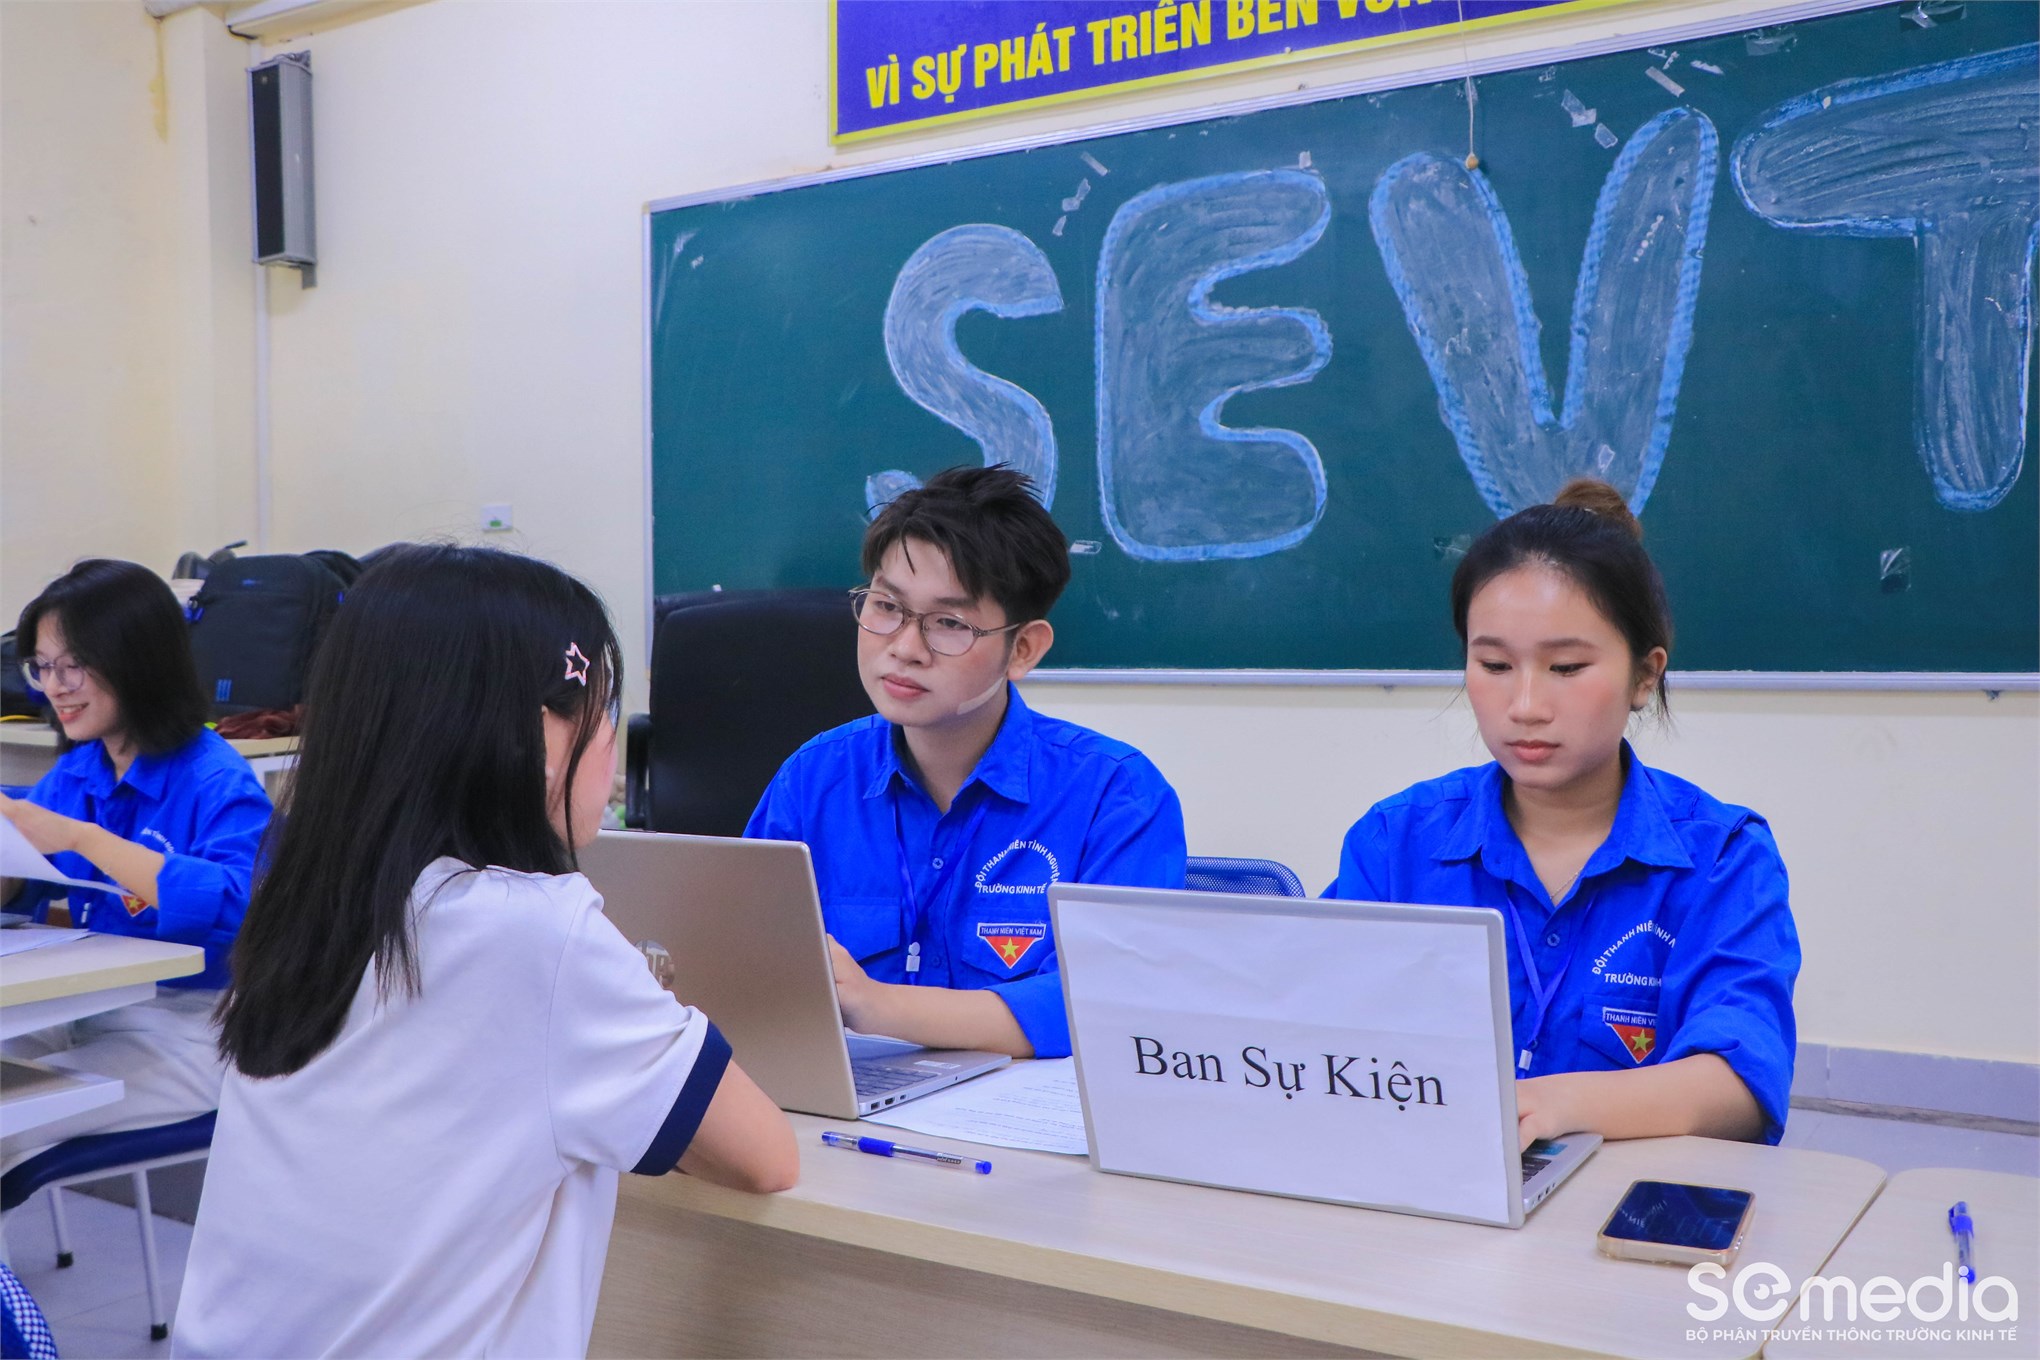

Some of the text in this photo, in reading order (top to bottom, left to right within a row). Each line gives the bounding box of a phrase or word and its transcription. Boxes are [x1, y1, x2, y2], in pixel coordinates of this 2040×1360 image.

[866, 54, 899, 109] VÌ
[912, 44, 967, 103] SỰ
[974, 22, 1075, 88] PHÁT
[974, 871, 987, 888] ĐỘI
[1028, 839, 1049, 856] TÌNH
[978, 882, 1048, 894] TRƯỜNG KINH TẾ
[1592, 956, 1608, 975] ĐỘI
[1603, 928, 1635, 957] THANH
[1604, 972, 1648, 986] TRƯỜNG
[1606, 1013, 1630, 1023] THANH
[1631, 1016, 1647, 1025] NIÊN
[1129, 1035, 1448, 1111] Ban Sự Kiện
